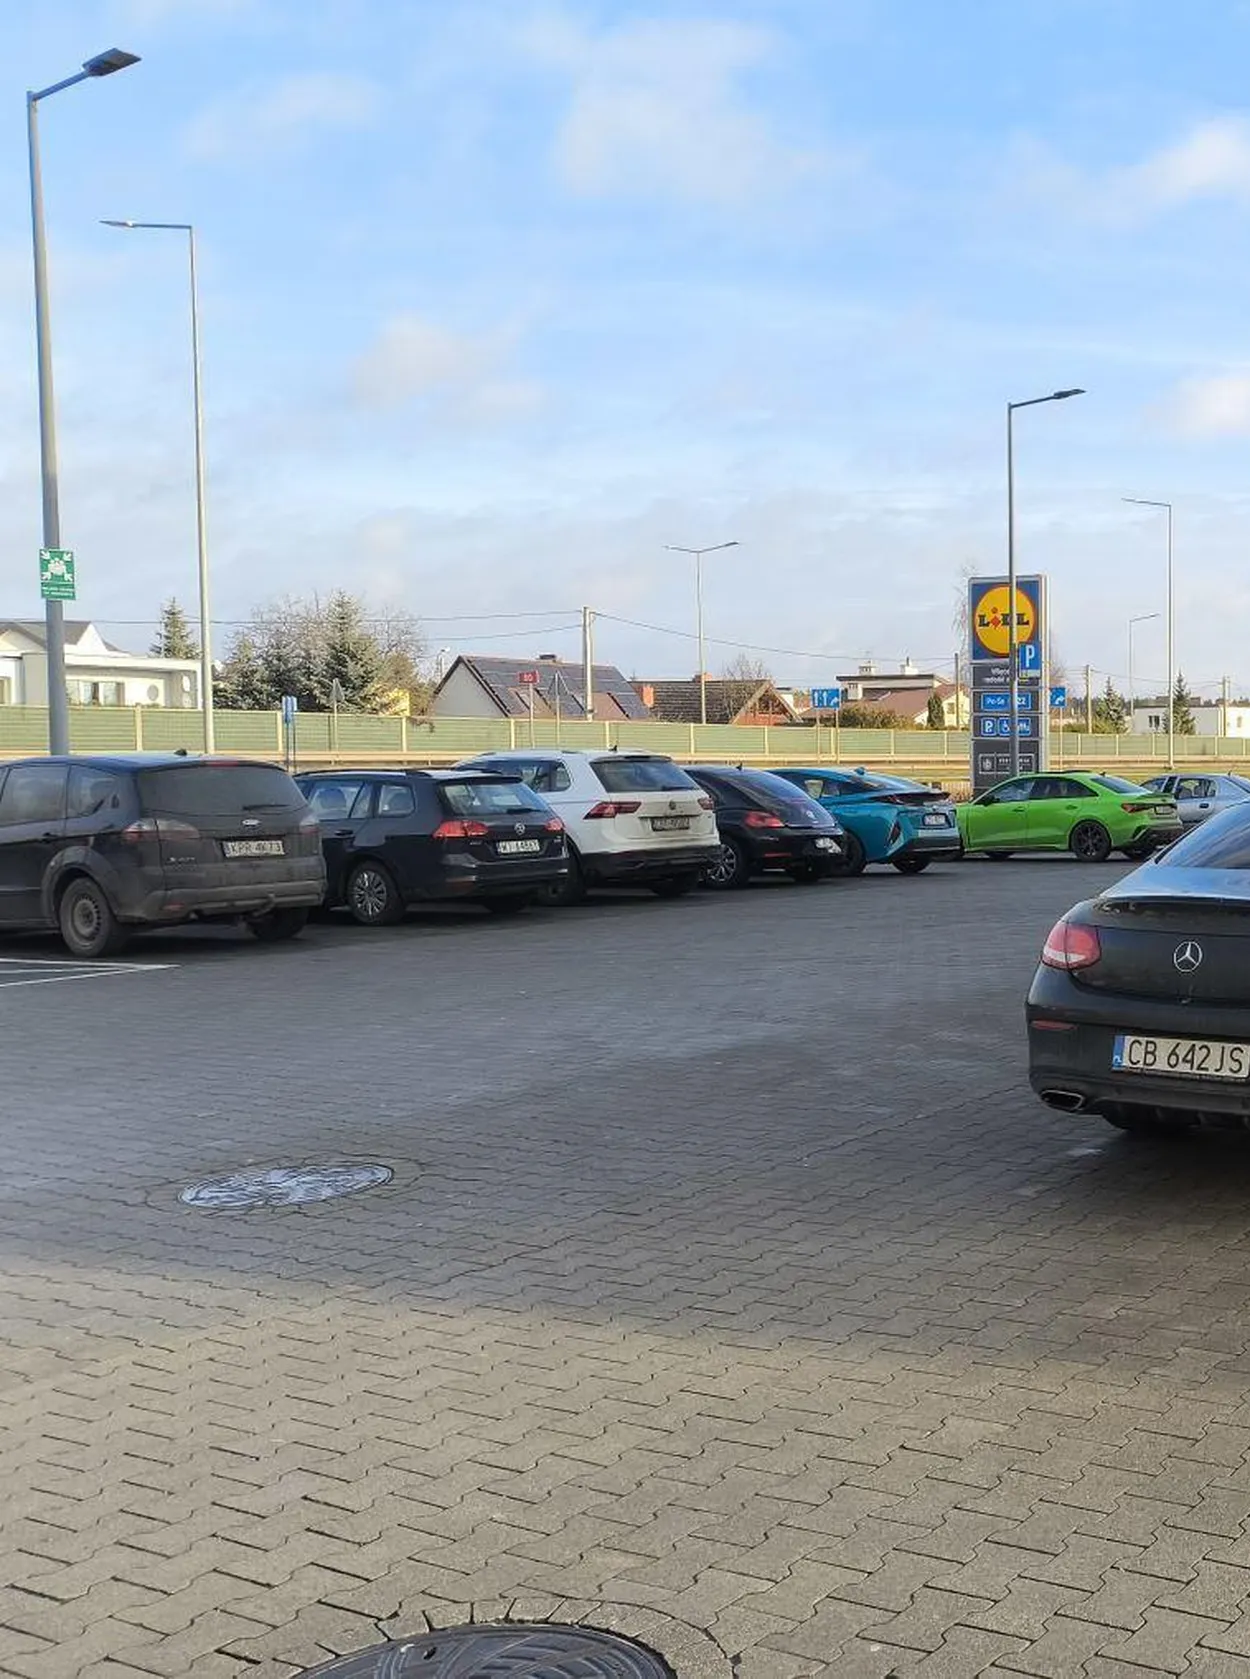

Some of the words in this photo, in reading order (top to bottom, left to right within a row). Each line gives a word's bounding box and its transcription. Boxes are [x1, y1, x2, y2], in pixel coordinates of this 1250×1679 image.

[1025, 644, 1035, 668] P
[1128, 1039, 1158, 1067] CB
[1166, 1042, 1245, 1074] 642JS
